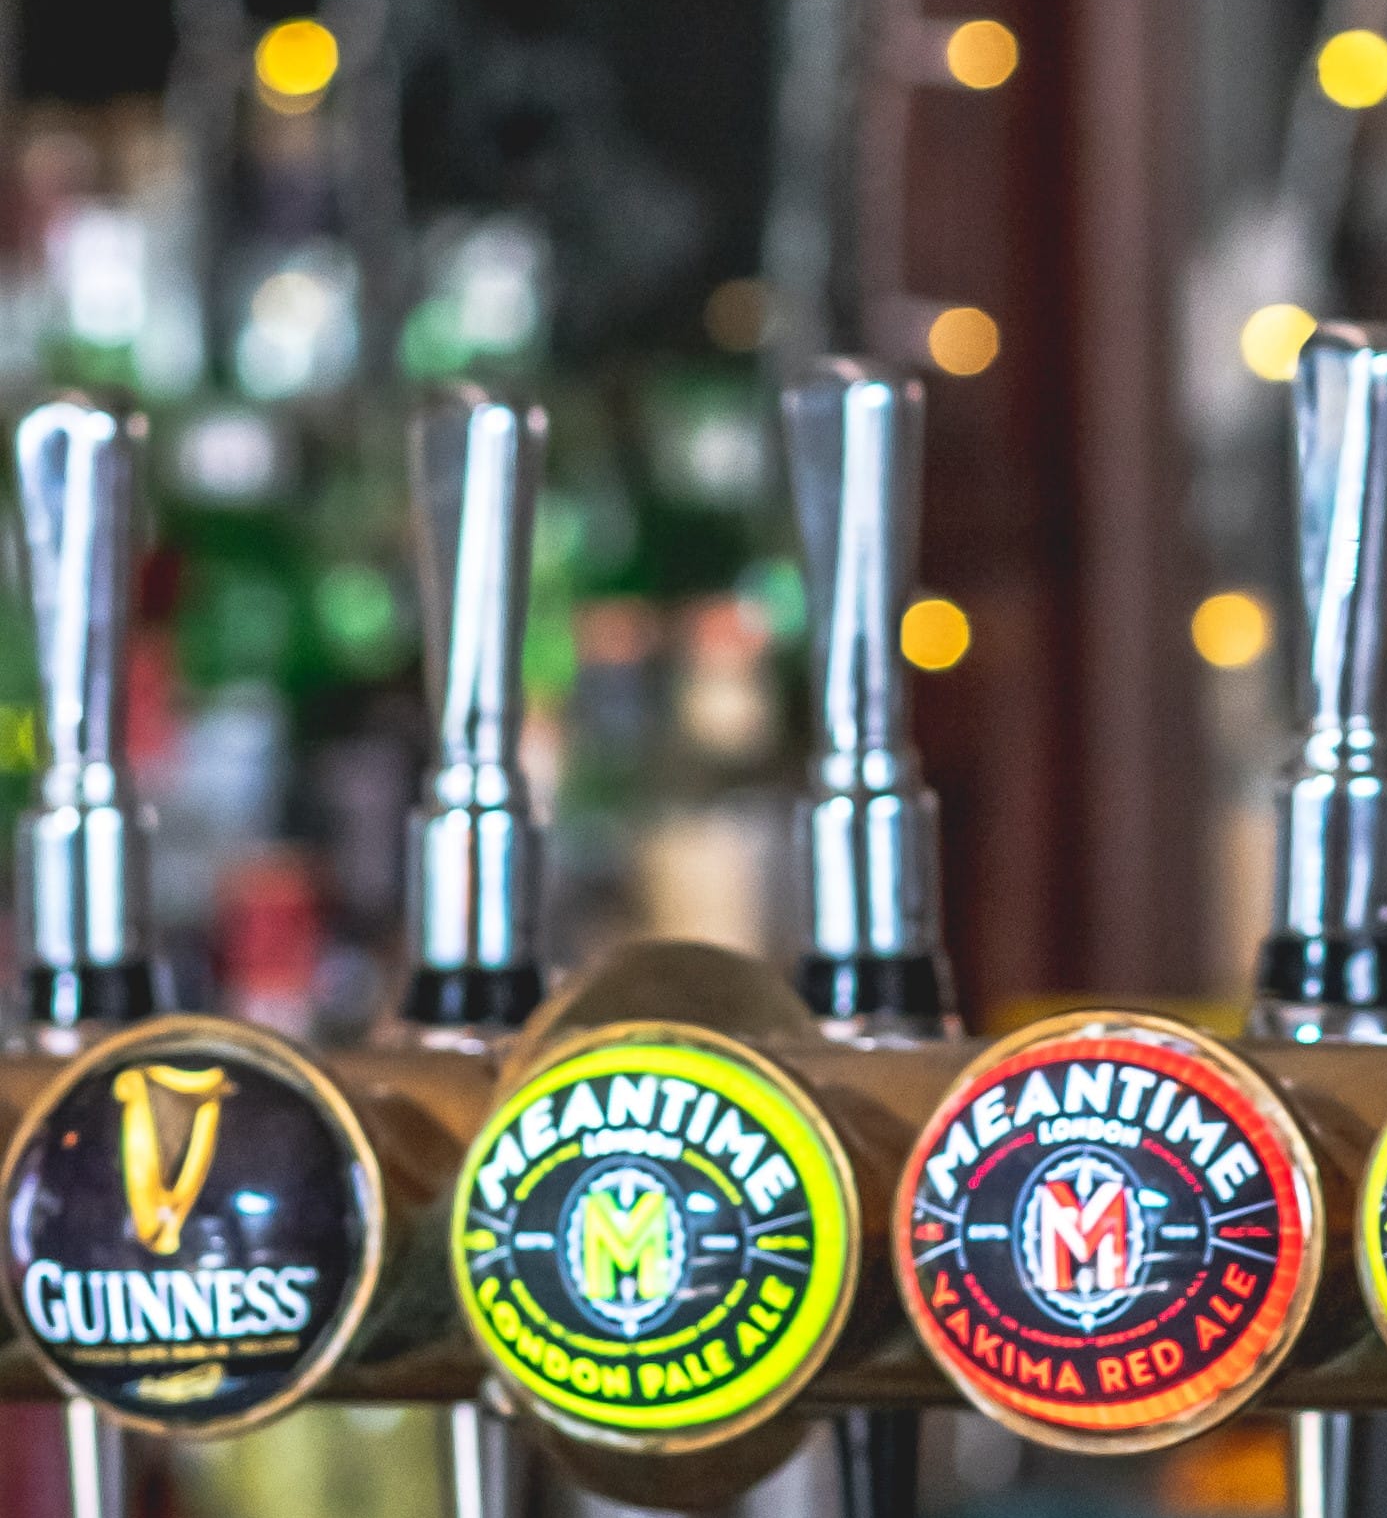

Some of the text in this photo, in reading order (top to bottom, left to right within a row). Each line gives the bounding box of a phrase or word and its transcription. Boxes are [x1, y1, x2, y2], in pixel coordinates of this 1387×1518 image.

[476, 1074, 797, 1215] MEANTIME
[927, 1062, 1259, 1202] MEANTIME
[1038, 1116, 1144, 1149] LONDON
[24, 1259, 318, 1345] GUINNESS
[478, 1276, 632, 1399] LONDON
[637, 1339, 735, 1400] PALE
[735, 1274, 796, 1357] ALE
[931, 1270, 1086, 1395] YAKIMA
[1099, 1339, 1185, 1394] RED
[1195, 1263, 1258, 1351] ALE
